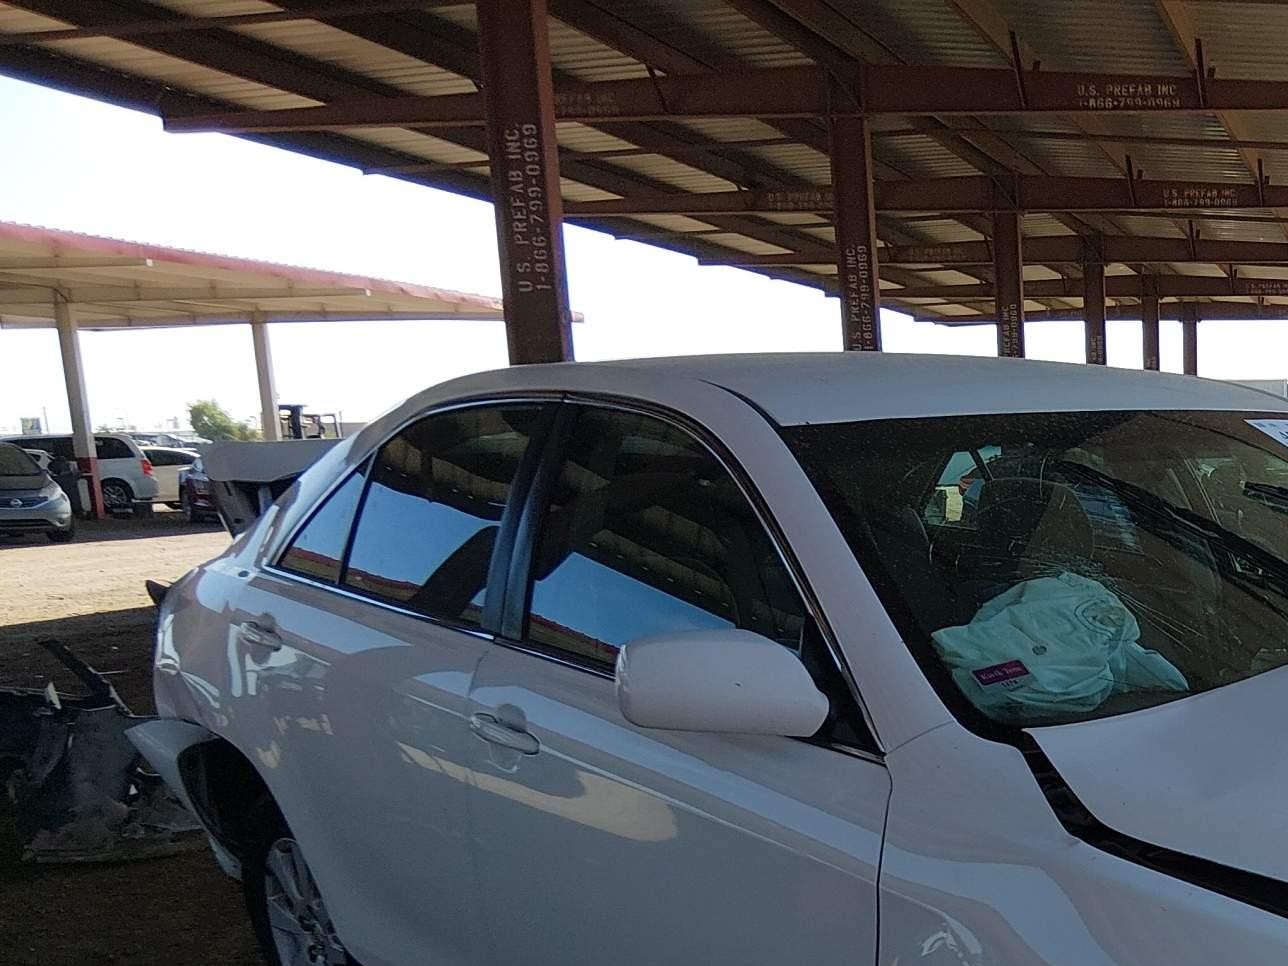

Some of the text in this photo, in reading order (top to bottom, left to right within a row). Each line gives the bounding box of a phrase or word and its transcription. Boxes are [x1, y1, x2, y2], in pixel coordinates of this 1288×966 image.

[504, 123, 522, 160] INC.
[508, 169, 530, 245] PREFAB
[522, 123, 552, 291] 1-866-799-0969
